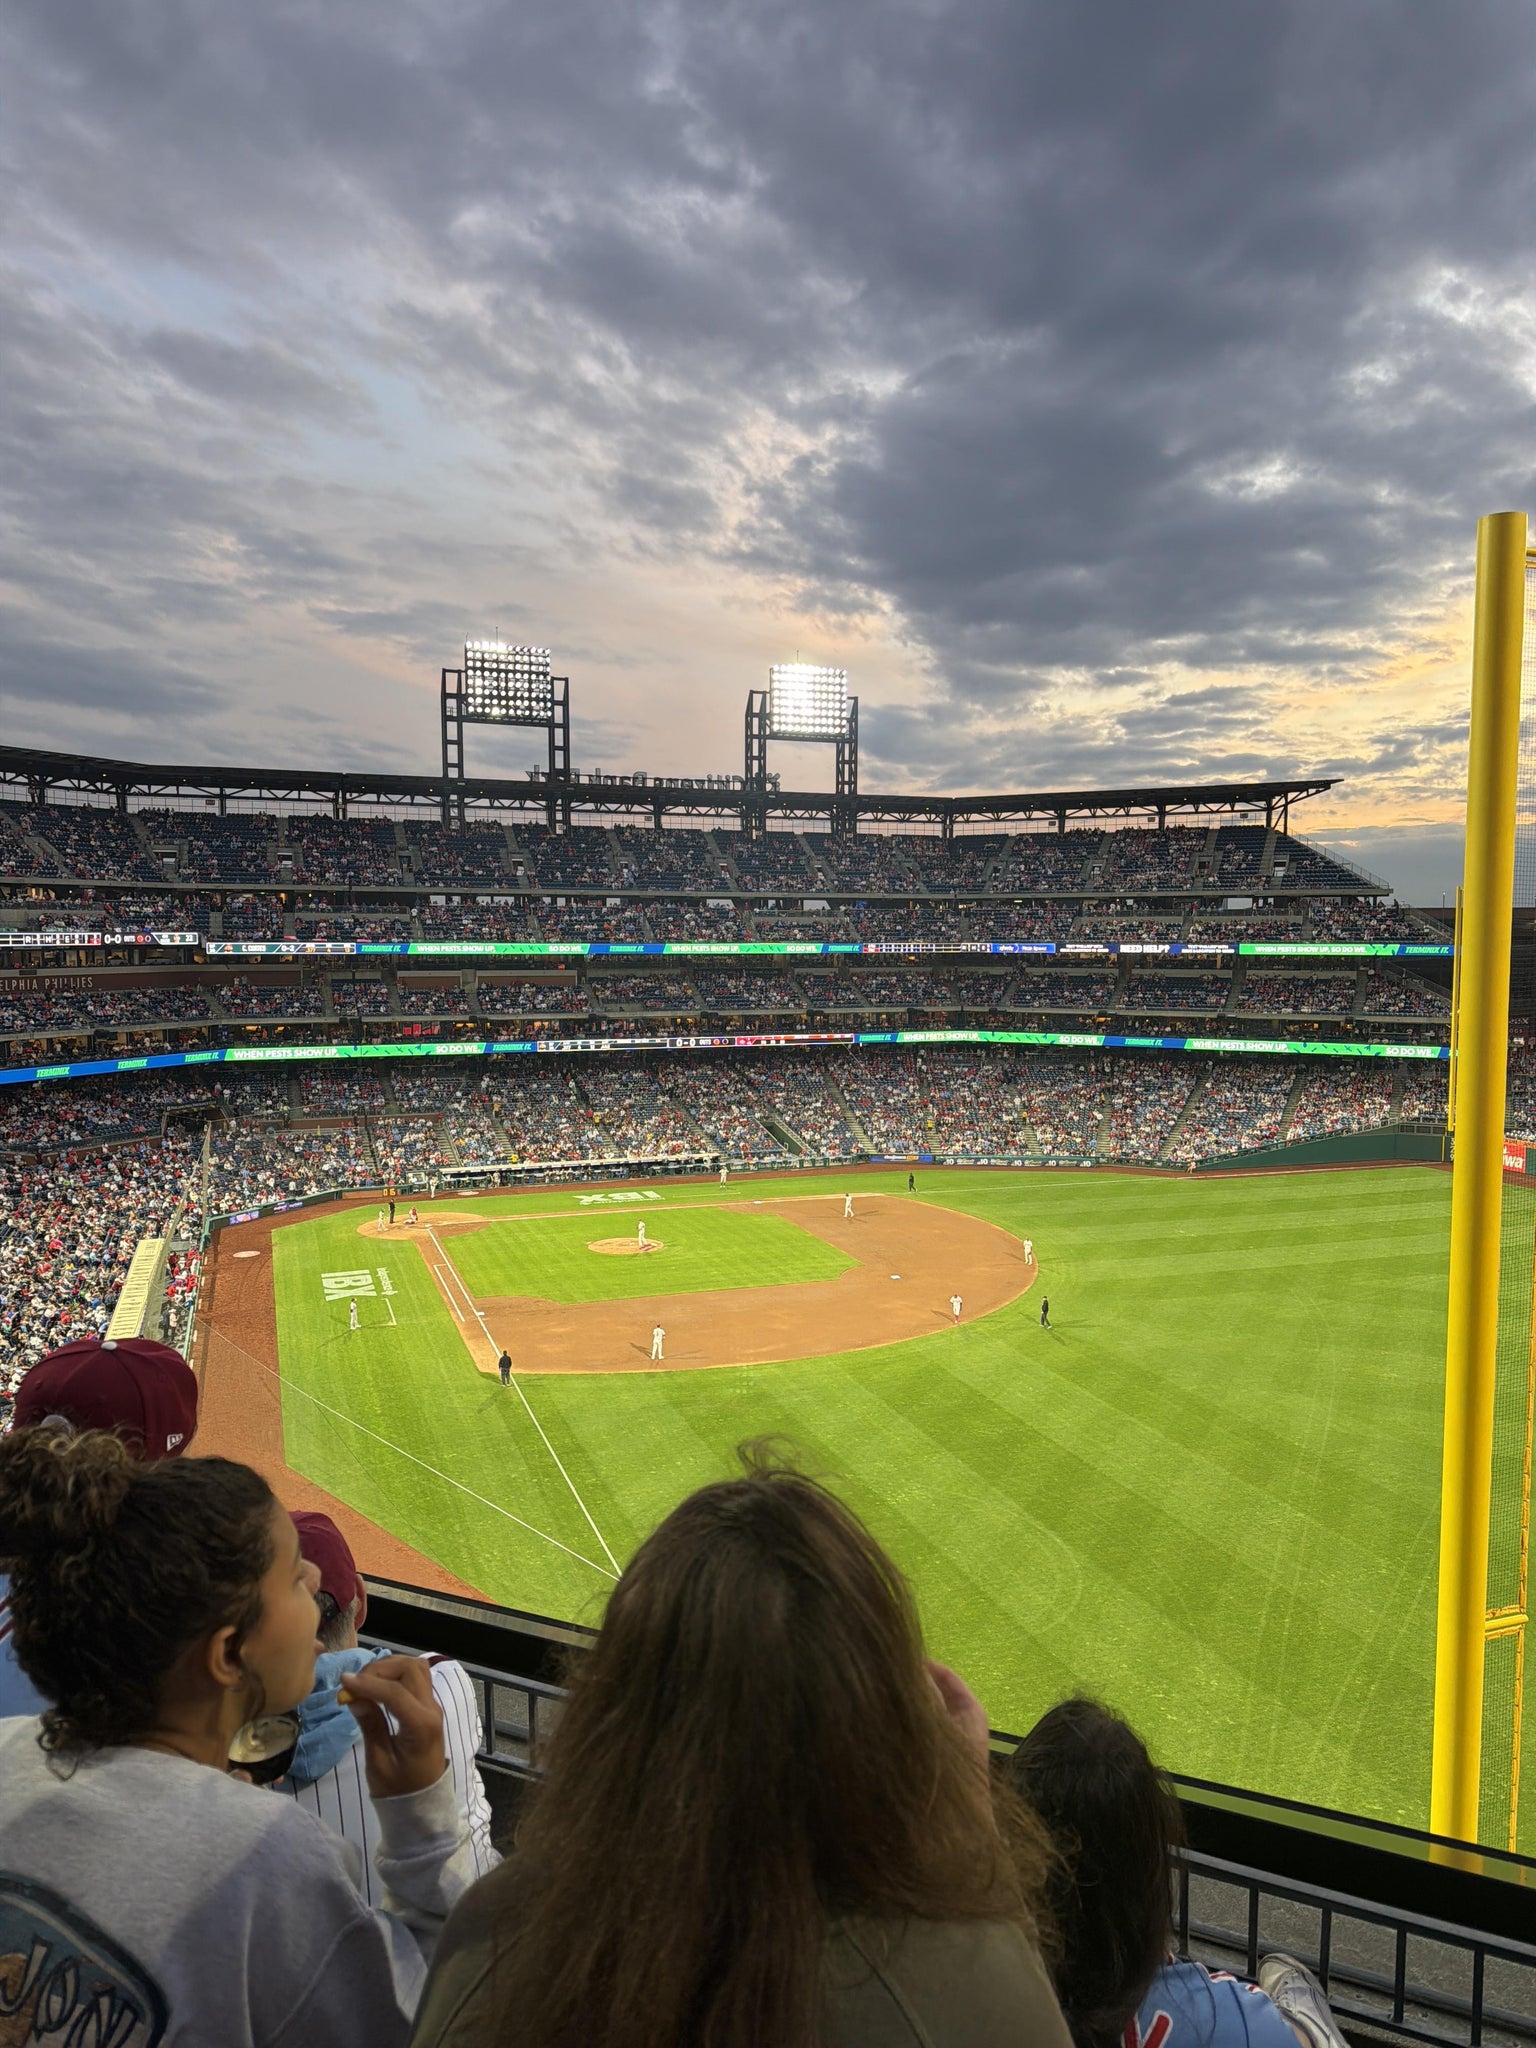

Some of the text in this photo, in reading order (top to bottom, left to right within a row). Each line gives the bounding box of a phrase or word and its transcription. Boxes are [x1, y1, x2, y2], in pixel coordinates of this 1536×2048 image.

[234, 1050, 263, 1058] WHEN
[294, 1049, 323, 1057] SHOW
[36, 1066, 70, 1078] TERMINIX
[321, 1269, 377, 1301] IBX
